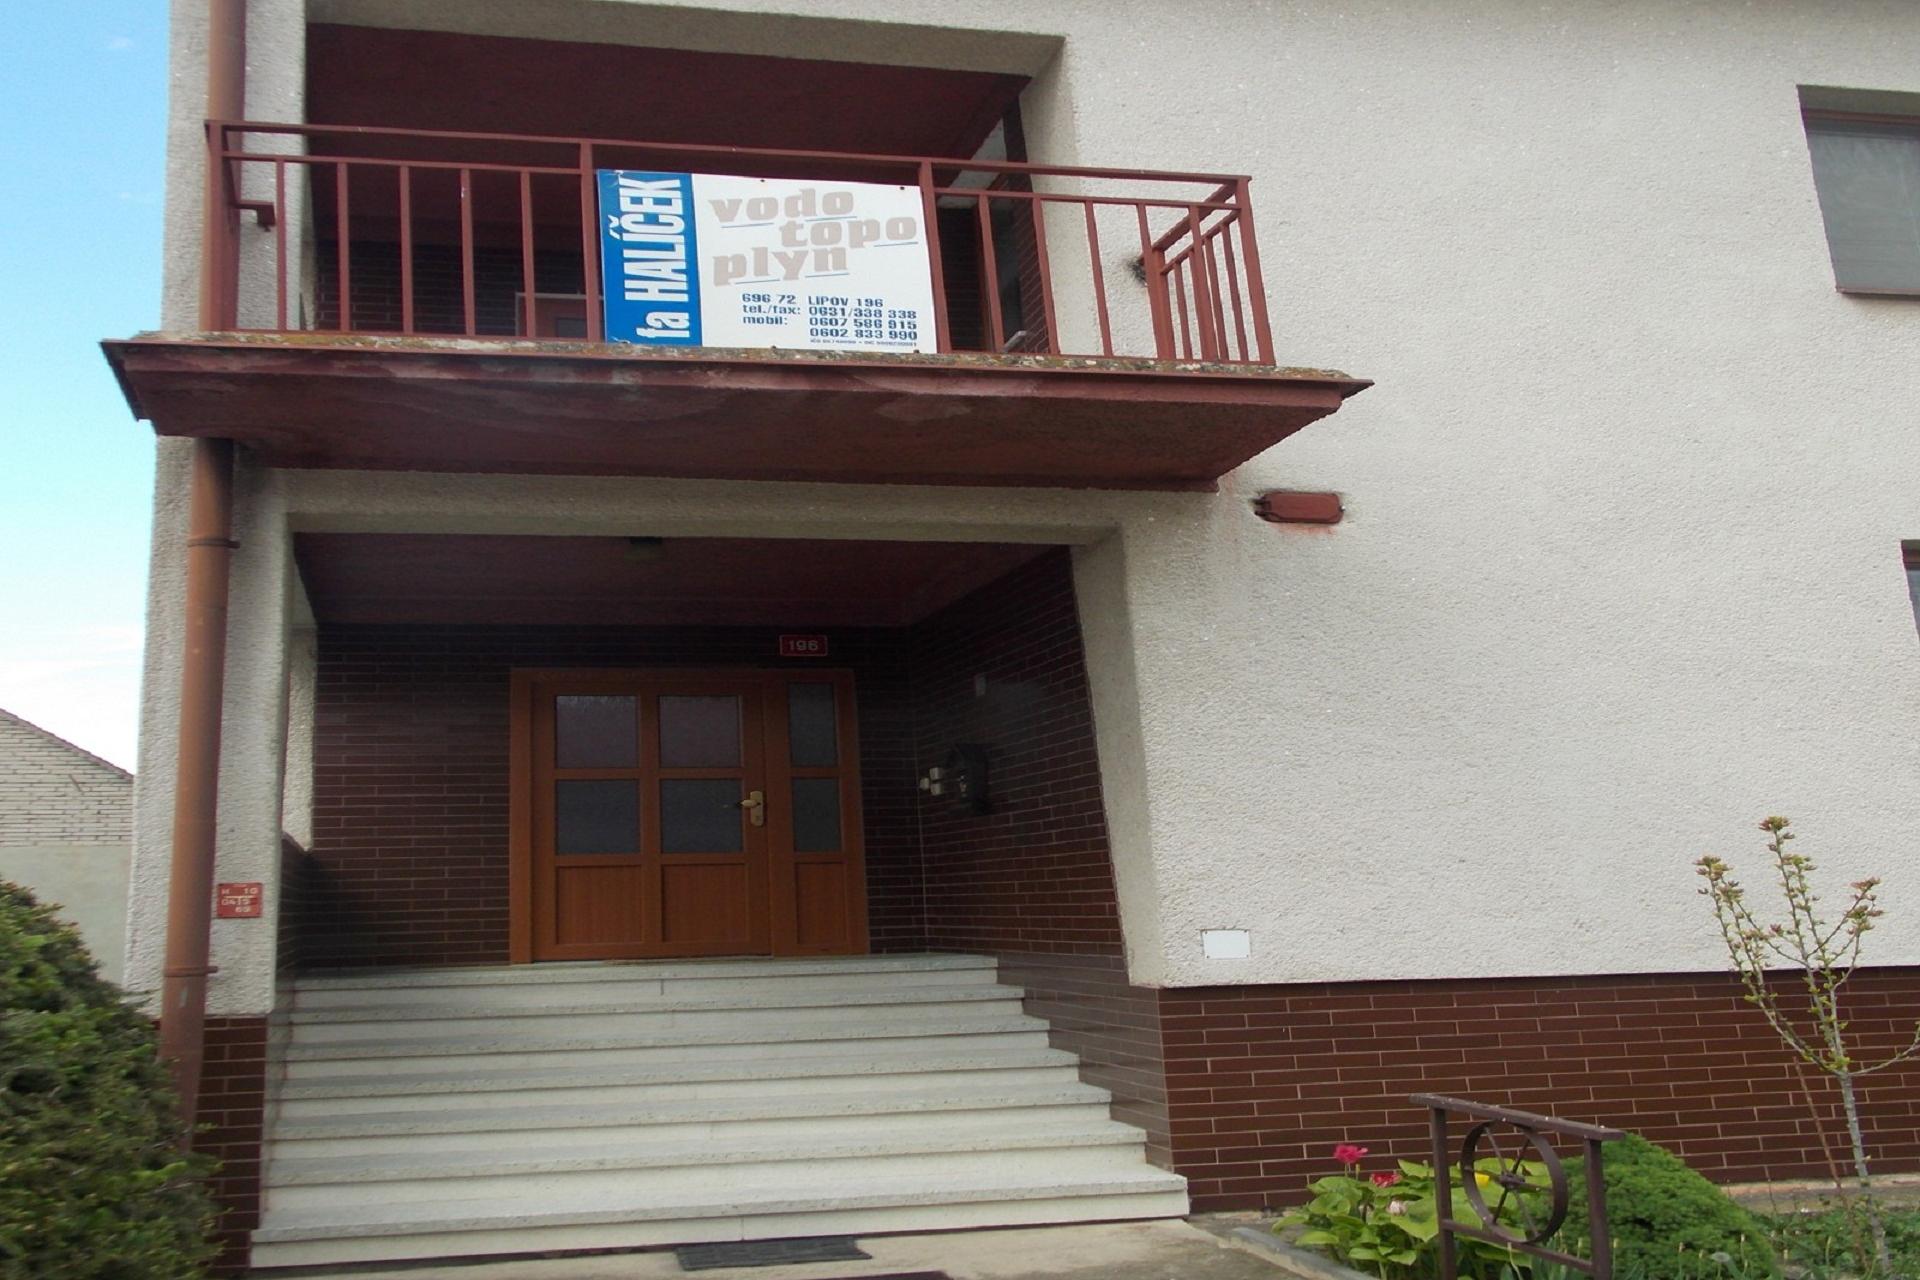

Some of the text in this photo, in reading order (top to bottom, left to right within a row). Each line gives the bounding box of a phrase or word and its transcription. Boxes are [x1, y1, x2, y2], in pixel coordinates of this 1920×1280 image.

[708, 188, 854, 223] vodo
[779, 216, 917, 249] topo
[607, 176, 690, 338] fa HALÍČEK
[712, 246, 850, 287] plyn
[742, 293, 883, 307] 696 72 LIPOV 196
[742, 304, 917, 319] tel./fax: 0631/338 338
[743, 316, 788, 326] mobil:
[809, 317, 848, 327] 0607
[888, 319, 917, 330] 915
[810, 327, 918, 341] 0602 833 990
[789, 639, 818, 651] 196
